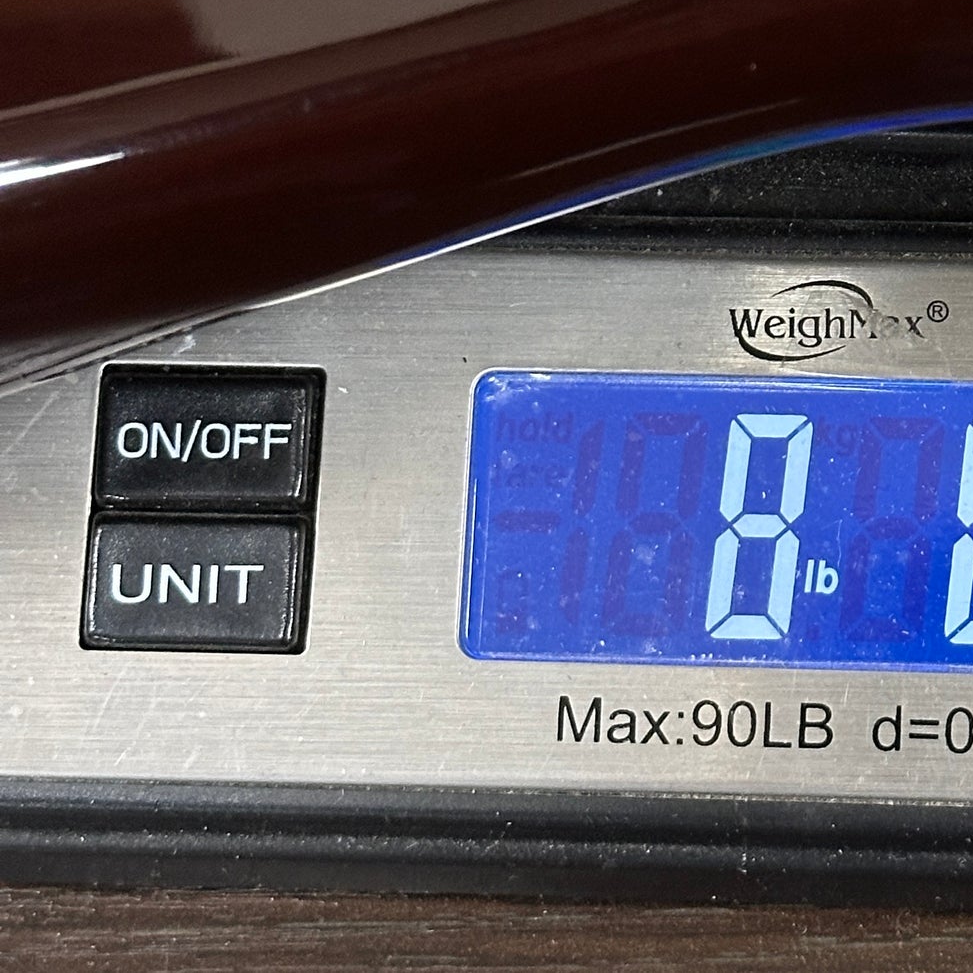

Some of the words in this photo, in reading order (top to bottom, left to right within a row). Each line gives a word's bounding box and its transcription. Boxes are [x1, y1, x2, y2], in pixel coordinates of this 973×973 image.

[117, 419, 292, 462] ON/OFF
[706, 413, 814, 639] 8
[804, 559, 839, 594] lb
[111, 563, 264, 604] UNIT
[556, 695, 834, 749] Max:90LB
